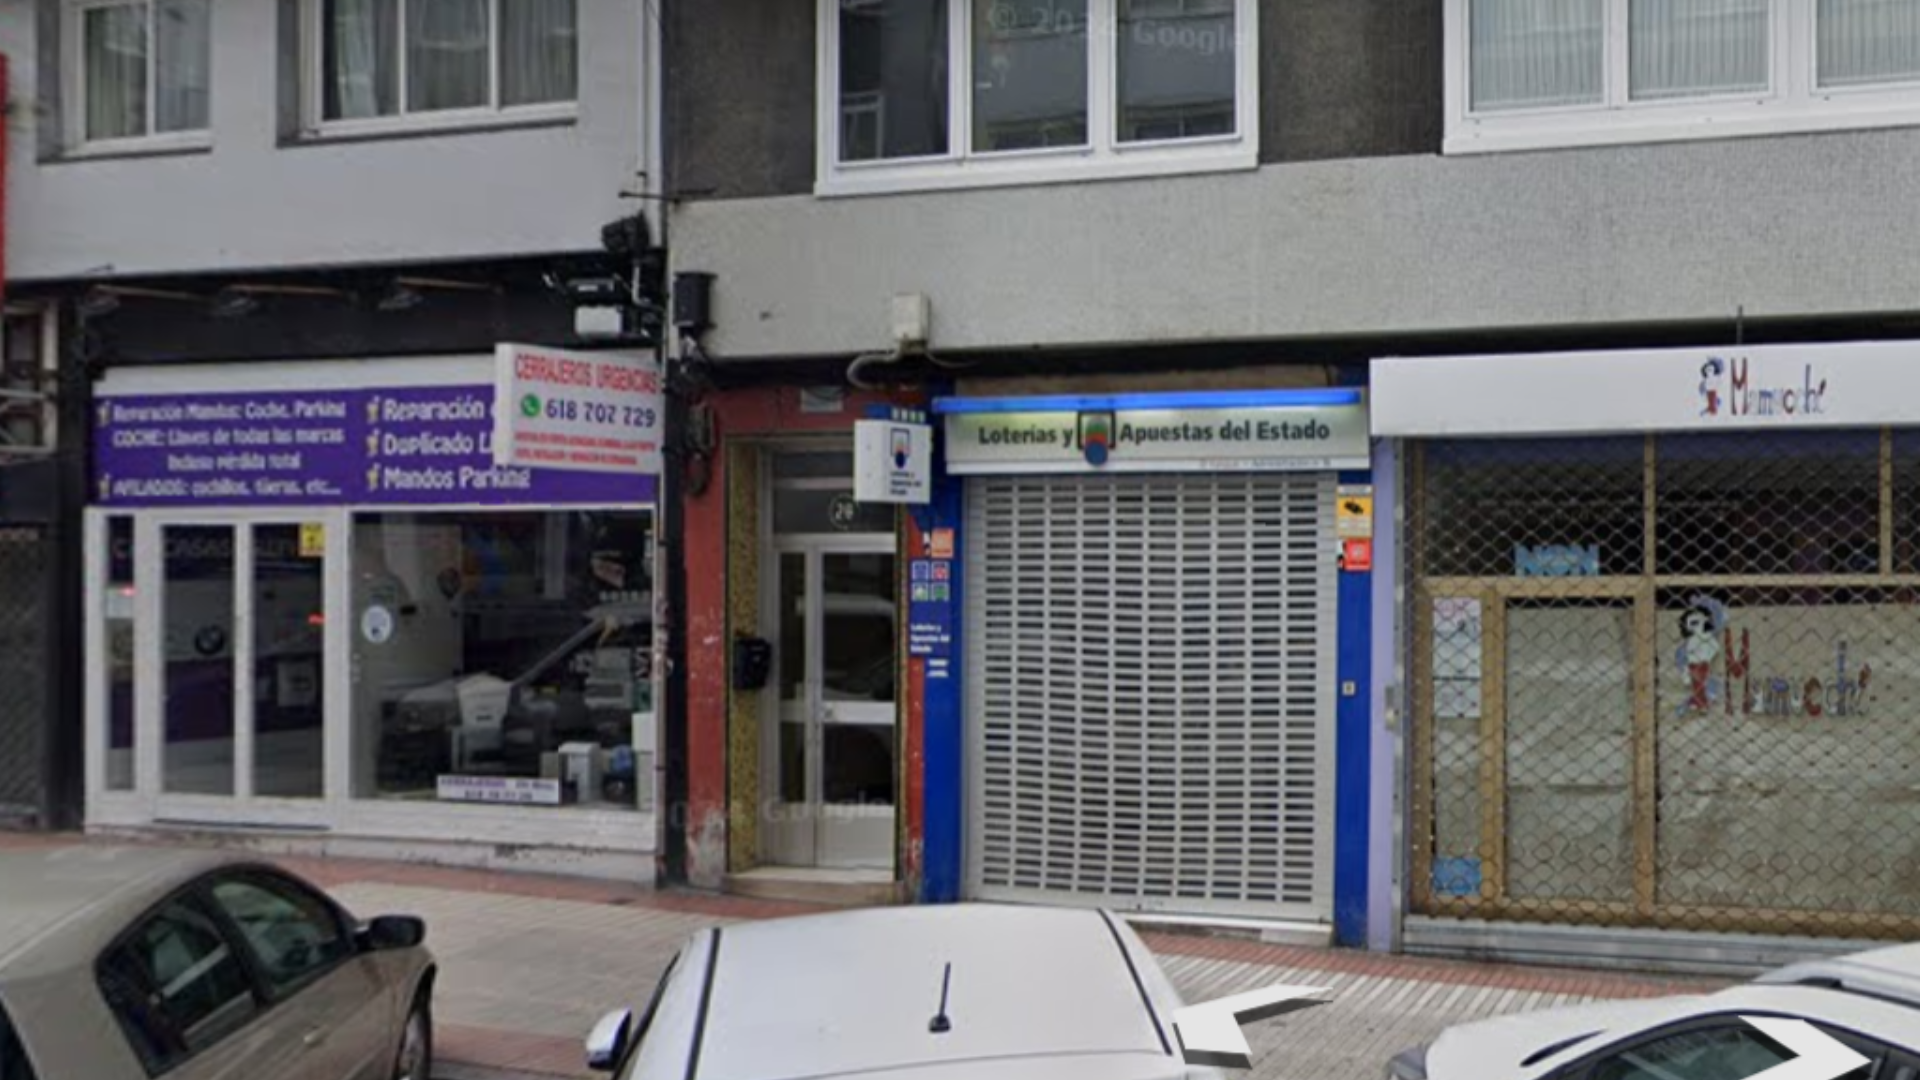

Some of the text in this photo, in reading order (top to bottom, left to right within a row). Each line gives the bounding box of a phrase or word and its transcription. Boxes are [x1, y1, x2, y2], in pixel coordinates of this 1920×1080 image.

[515, 352, 592, 387] CERRAJEROS
[383, 395, 484, 422] Reparación
[545, 398, 656, 428] 618 707 729
[213, 428, 230, 445] de
[383, 432, 473, 456] Duplicado
[978, 419, 1330, 448] Loterías y Apuestas del Estado
[383, 467, 454, 489] Mandos
